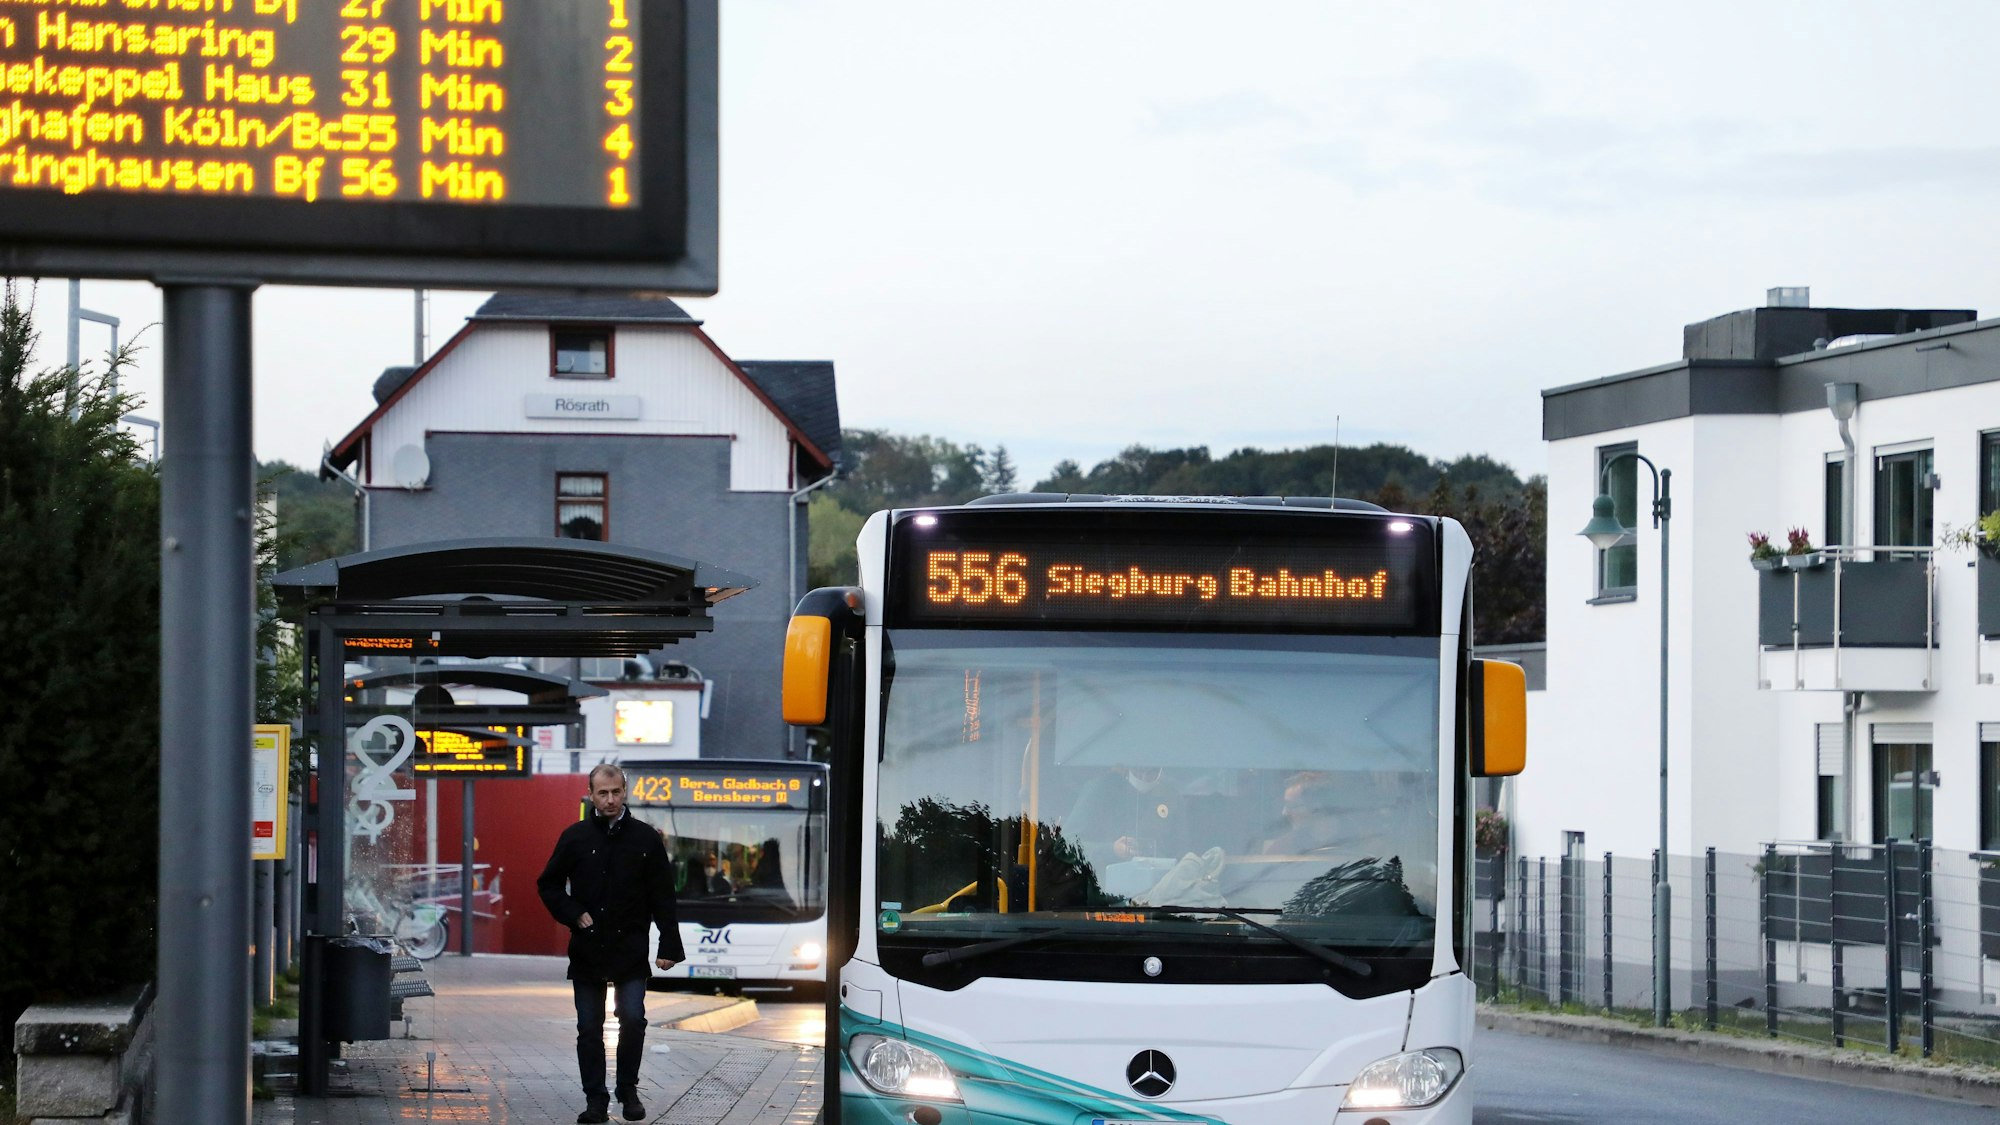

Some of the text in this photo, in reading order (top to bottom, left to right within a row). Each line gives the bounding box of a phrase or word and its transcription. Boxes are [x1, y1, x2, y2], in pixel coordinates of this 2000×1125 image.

[38, 11, 274, 67] Hansaring
[340, 25, 396, 63] 29
[421, 29, 503, 67] Min
[605, 36, 633, 72] 2
[0, 56, 633, 116] ekeppel Haus 31 Min 3
[421, 116, 503, 156] Min
[605, 123, 633, 160] 4
[274, 155, 325, 203] Bf
[341, 158, 398, 196] 56
[421, 160, 504, 199] Min
[609, 167, 630, 204] 1
[555, 398, 610, 412] Rösrath
[927, 552, 1388, 604] 556 Siegburg Bahnhof
[632, 776, 673, 801] 423
[722, 778, 786, 791] Gladbach
[693, 791, 771, 803] Bensberg
